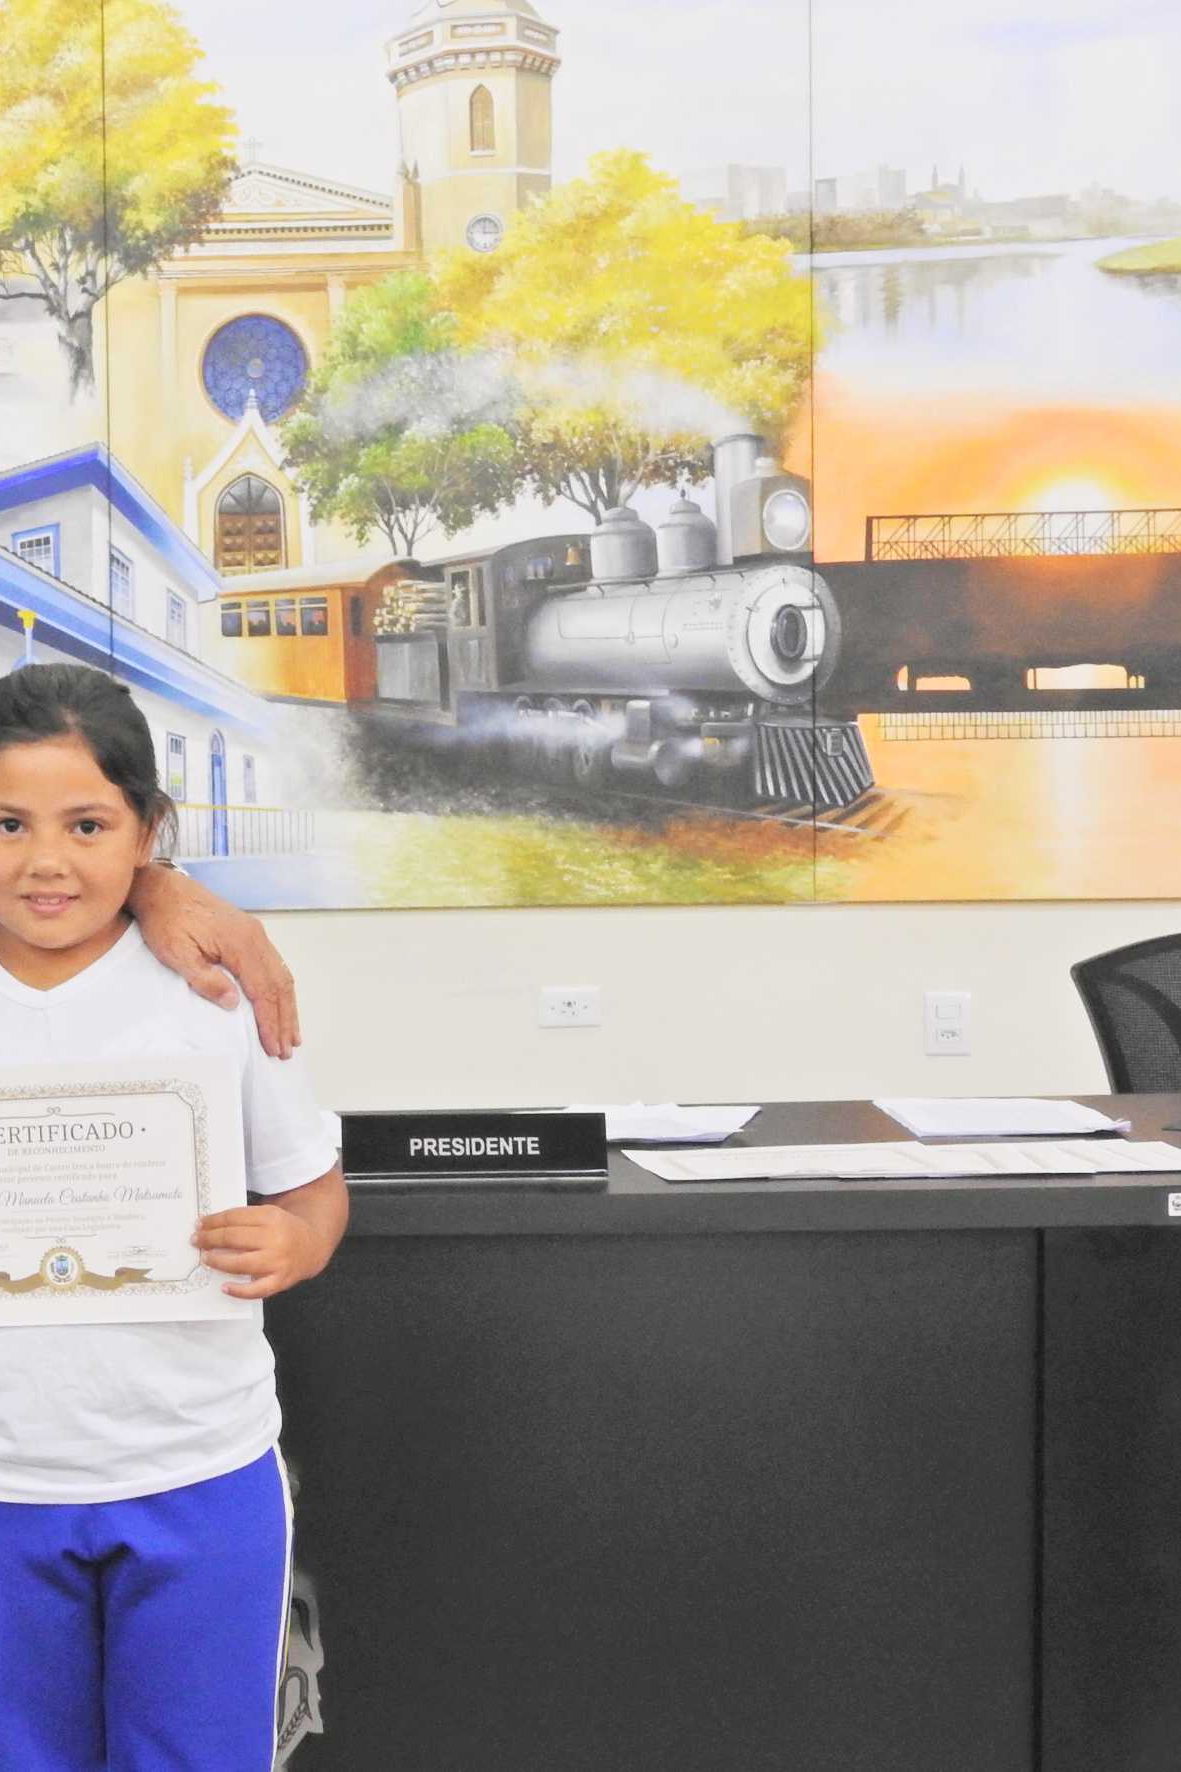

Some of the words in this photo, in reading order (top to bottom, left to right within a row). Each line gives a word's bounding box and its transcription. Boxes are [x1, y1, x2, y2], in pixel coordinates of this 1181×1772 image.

[7, 1148, 20, 1157] DE
[22, 1144, 106, 1156] RECONHECIMENTO
[409, 1136, 540, 1157] PRESIDENTE
[32, 1163, 42, 1172] de
[44, 1162, 70, 1172] Castro
[72, 1162, 88, 1171] tem
[96, 1161, 121, 1170] honra
[121, 1160, 132, 1169] de
[133, 1158, 167, 1168] conferir
[0, 1175, 15, 1184] este
[17, 1174, 52, 1185] presente
[53, 1171, 97, 1182] certificado
[98, 1173, 117, 1183] para
[59, 1187, 110, 1206] Castanho
[113, 1185, 184, 1203] Matsumoto
[45, 1215, 71, 1225] Projeto
[72, 1213, 106, 1223] Saudação
[1, 1224, 33, 1234] realizado
[35, 1225, 47, 1235] por
[48, 1224, 63, 1232] esta
[64, 1223, 81, 1232] Casa
